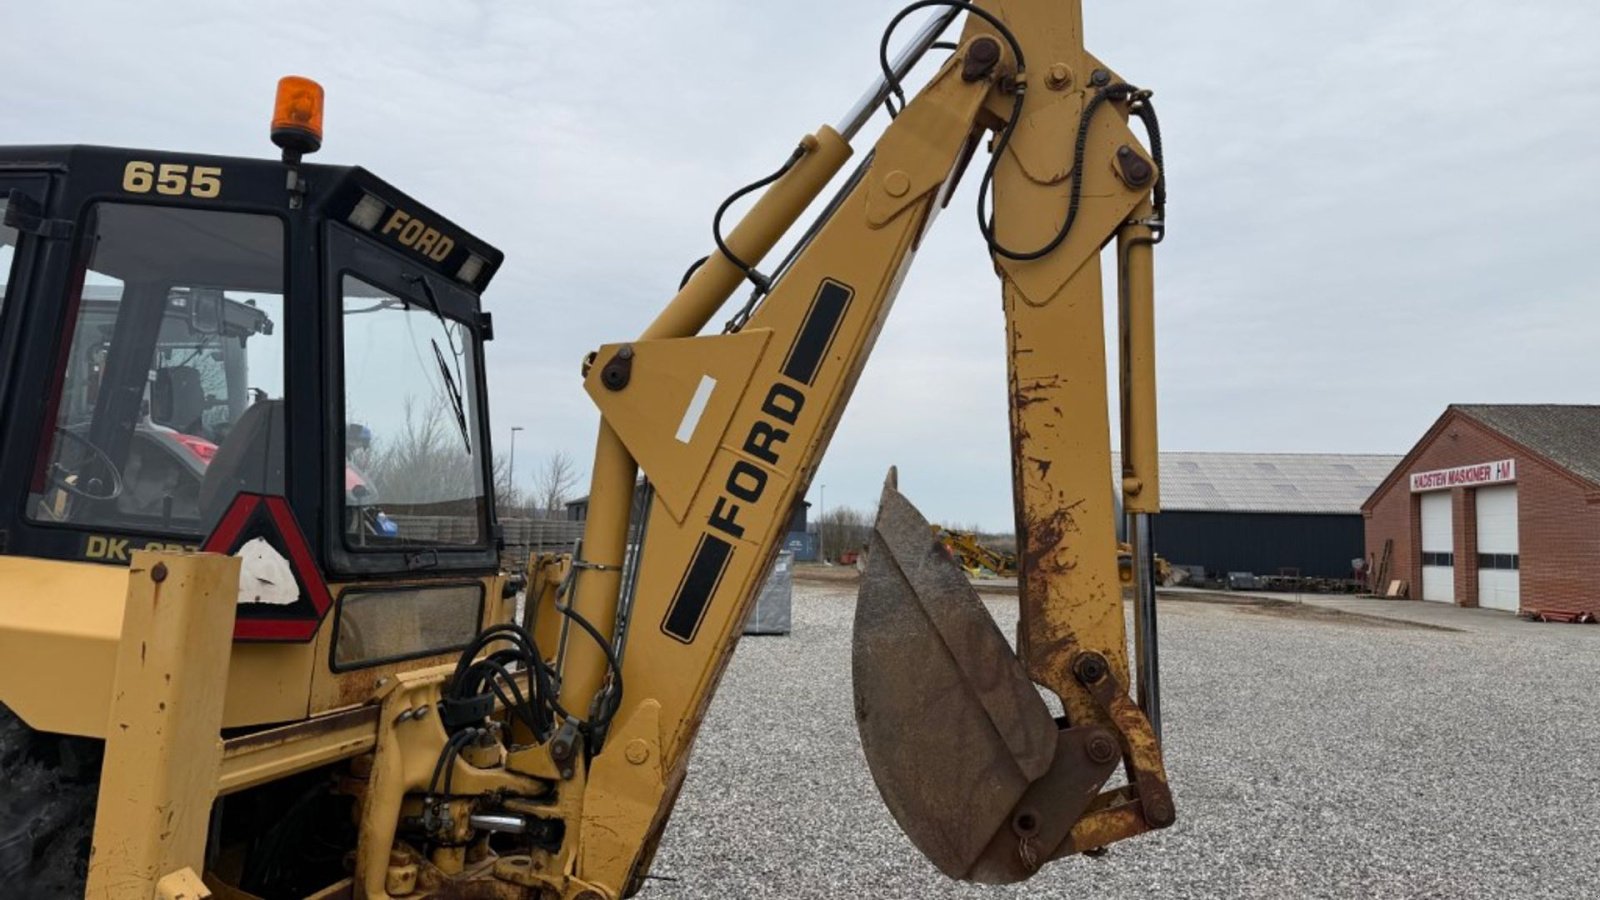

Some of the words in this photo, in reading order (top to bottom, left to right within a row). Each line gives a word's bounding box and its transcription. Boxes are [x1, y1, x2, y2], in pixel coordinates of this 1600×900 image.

[123, 161, 222, 198] 655
[381, 208, 455, 262] FORD
[707, 382, 806, 540] FORD
[1447, 465, 1491, 485] MASKINER
